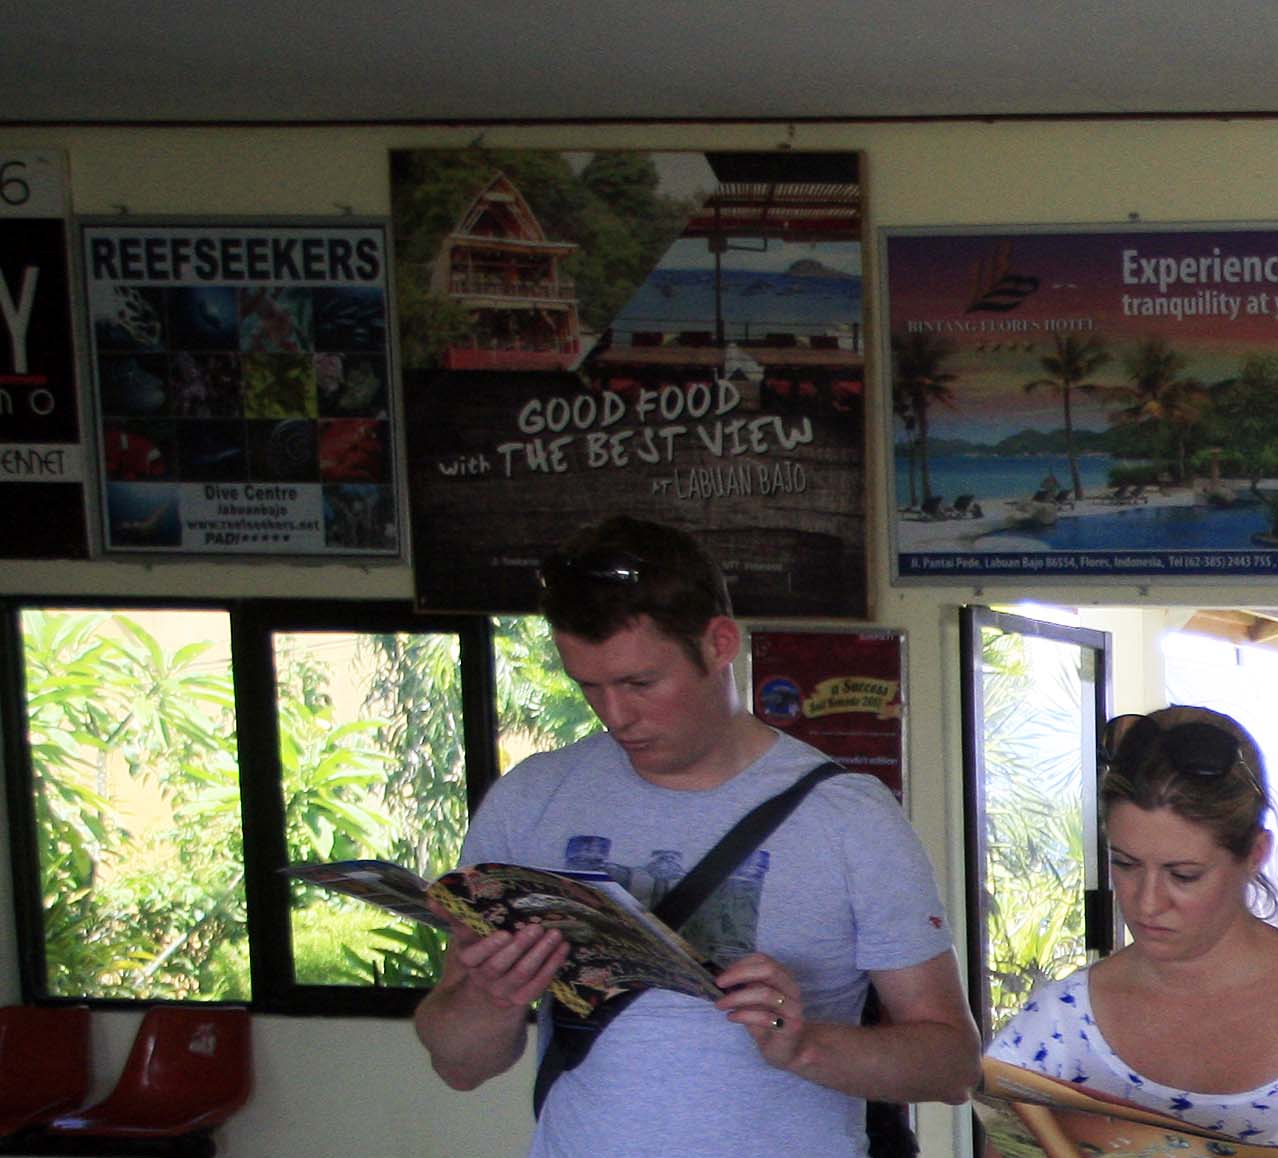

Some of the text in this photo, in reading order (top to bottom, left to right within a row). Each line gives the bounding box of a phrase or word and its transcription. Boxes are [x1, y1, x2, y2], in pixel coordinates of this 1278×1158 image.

[91, 237, 380, 281] REEFSEEKERS
[1122, 290, 1241, 319] tranquility
[1248, 293, 1270, 313] at
[517, 378, 741, 435] GOOD FOOD
[438, 414, 815, 478] with THE BEST VIEW
[205, 485, 298, 500] Dive Centre
[673, 467, 753, 500] LABUAN
[759, 461, 808, 495] BAJO
[984, 556, 1021, 570] Labuan
[1022, 556, 1043, 572] Bajo
